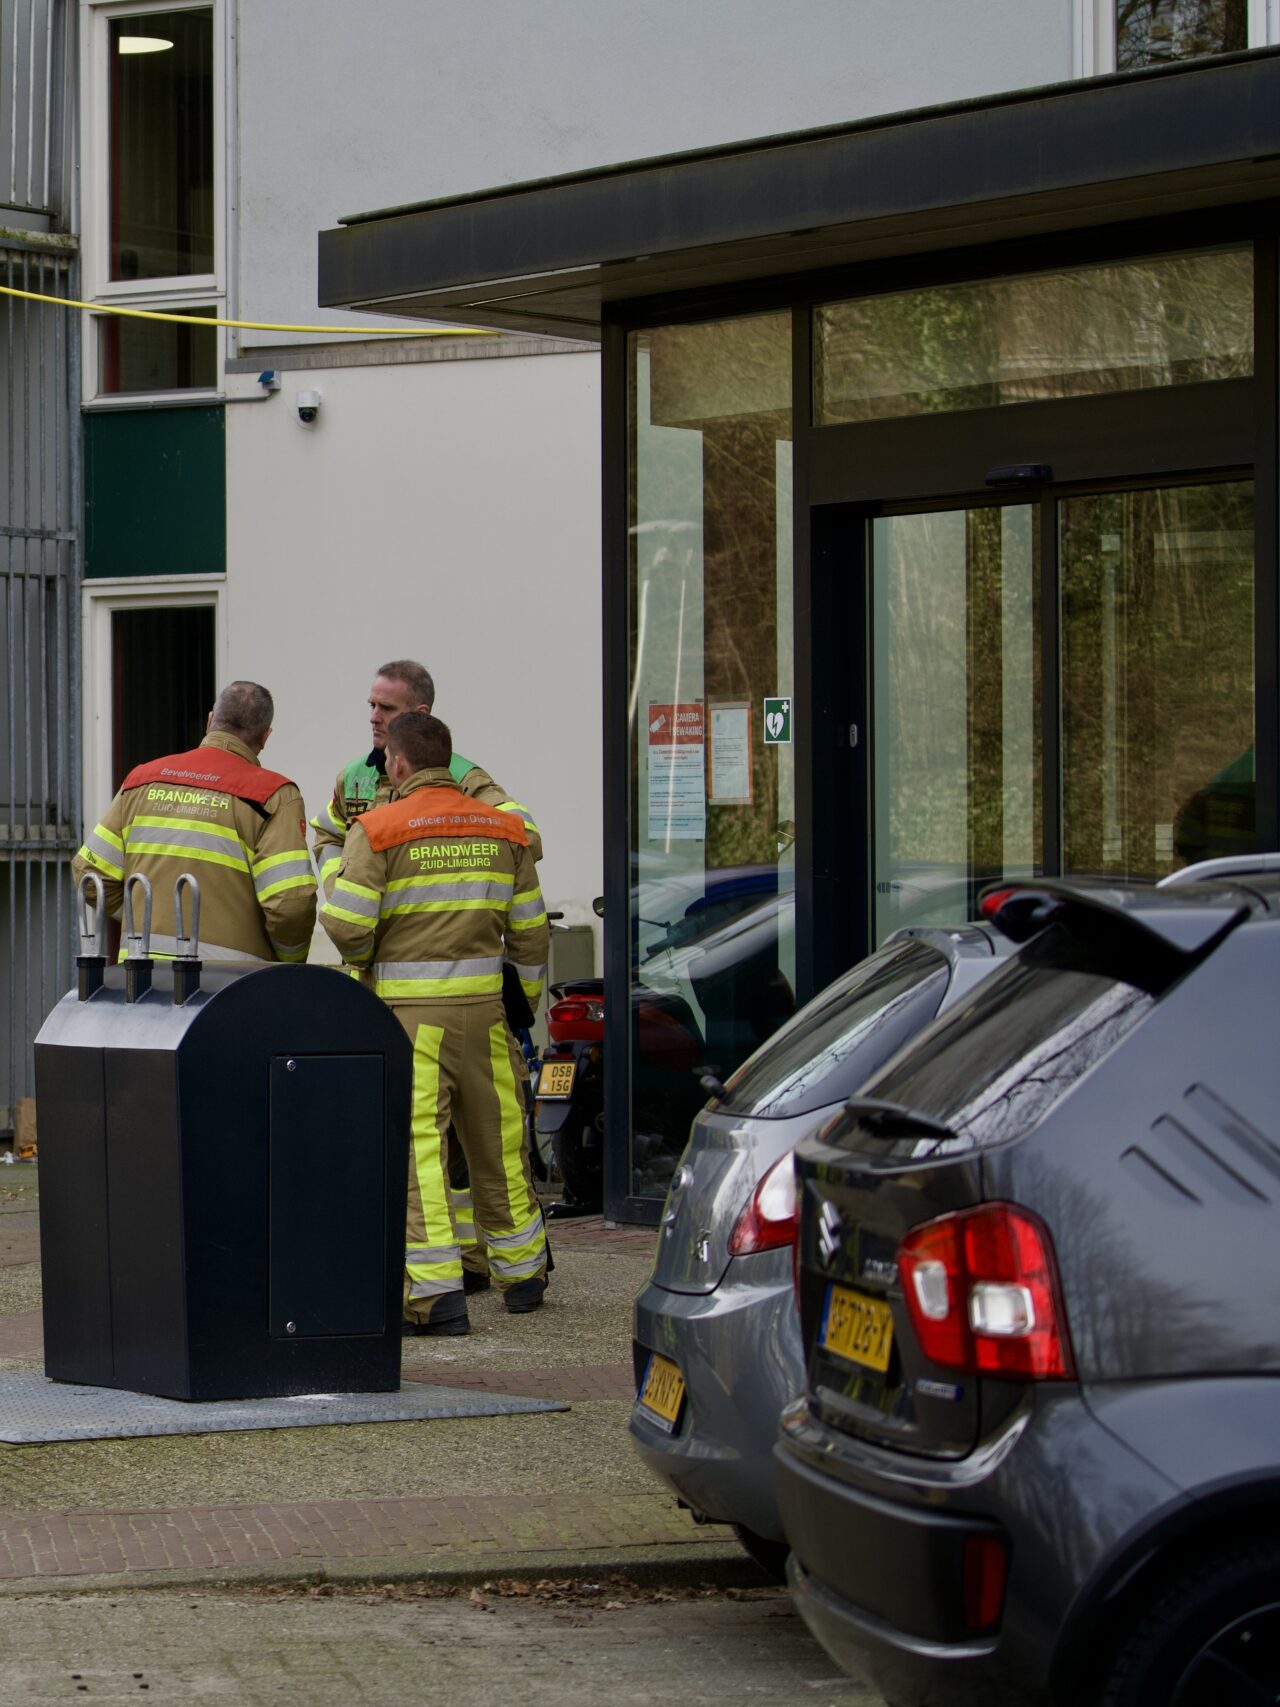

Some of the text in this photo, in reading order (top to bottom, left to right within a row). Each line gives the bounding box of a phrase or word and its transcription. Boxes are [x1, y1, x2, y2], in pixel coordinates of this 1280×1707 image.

[676, 712, 700, 722] CAMERA
[672, 726, 703, 737] BEWAKING
[160, 767, 221, 782] Bevelvoerder
[147, 789, 229, 809] BRANDWEER
[408, 816, 446, 828] Officier
[449, 815, 466, 824] van
[409, 843, 499, 861] BRANDWEER
[420, 857, 491, 870] ZUID-LIMBURG
[551, 1065, 572, 1078] DSB
[551, 1079, 570, 1092] 15G
